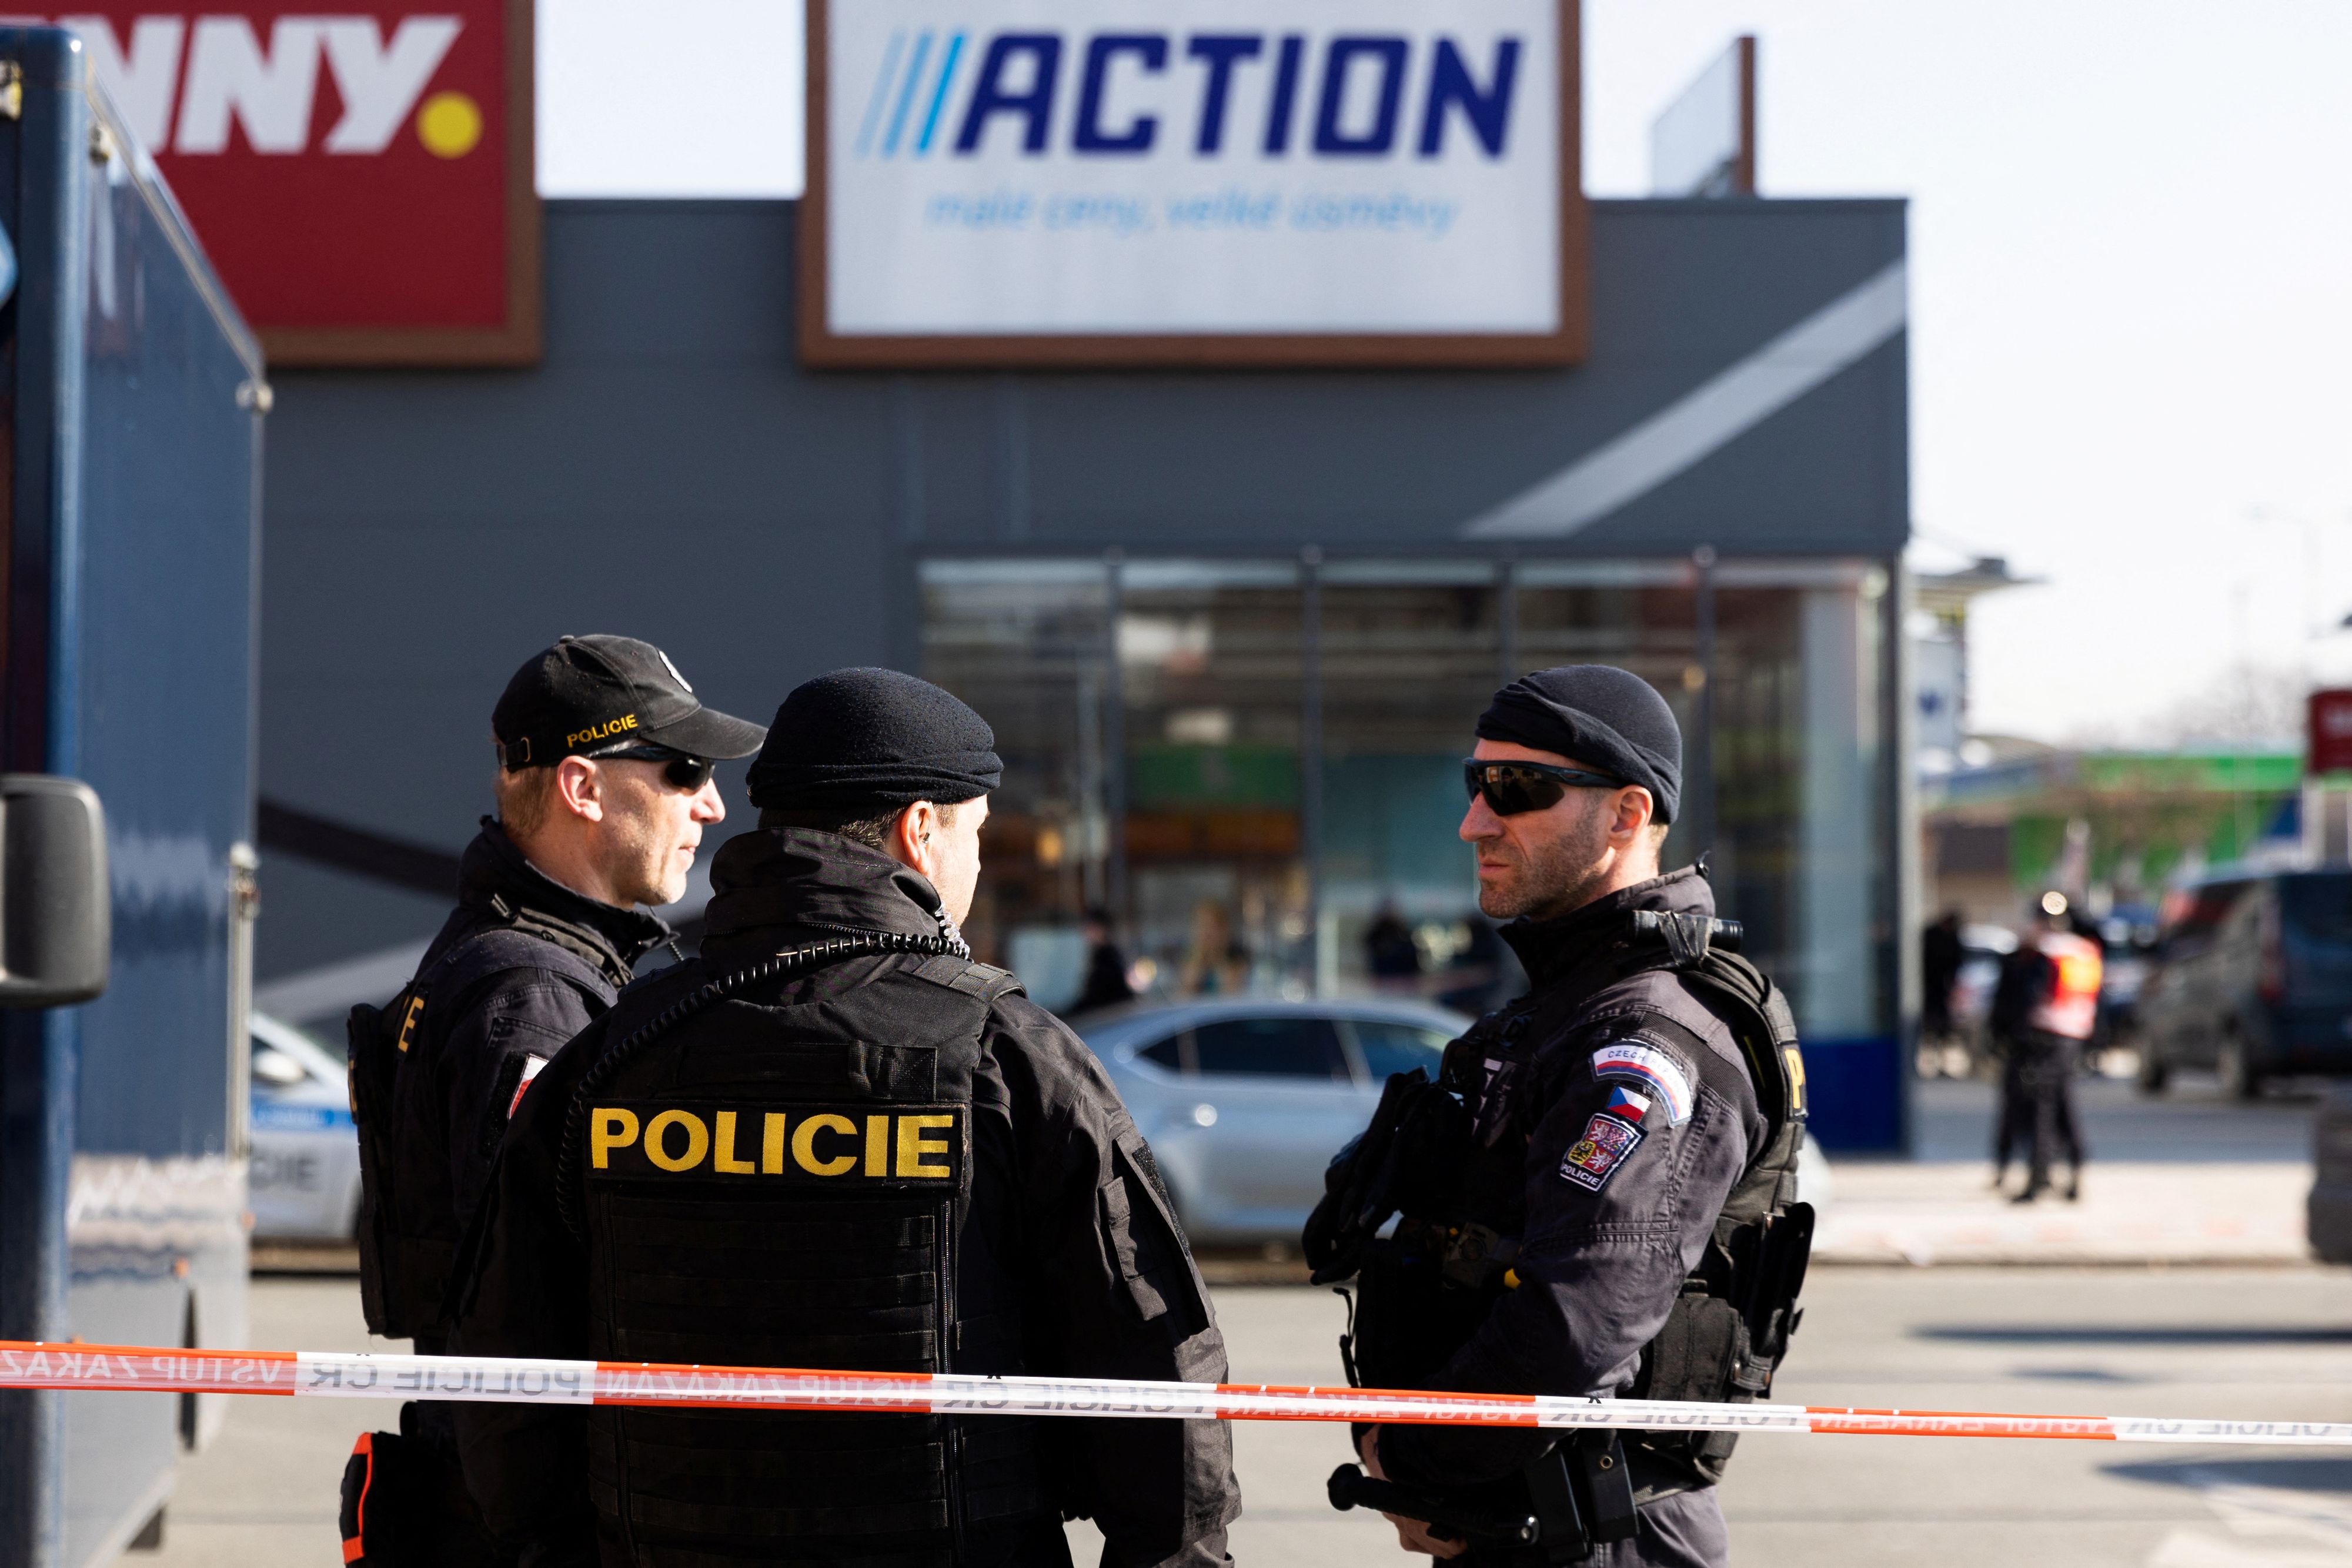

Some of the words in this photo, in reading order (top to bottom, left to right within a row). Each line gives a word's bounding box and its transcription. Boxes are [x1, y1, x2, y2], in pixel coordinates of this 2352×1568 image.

[0, 15, 483, 159] NNY.
[950, 32, 1524, 158] ACTION
[567, 714, 638, 748] POLICIE
[1608, 1050, 1646, 1062] CZECH
[591, 1108, 953, 1178] POLICIE
[1562, 1164, 1600, 1186] POLICIE
